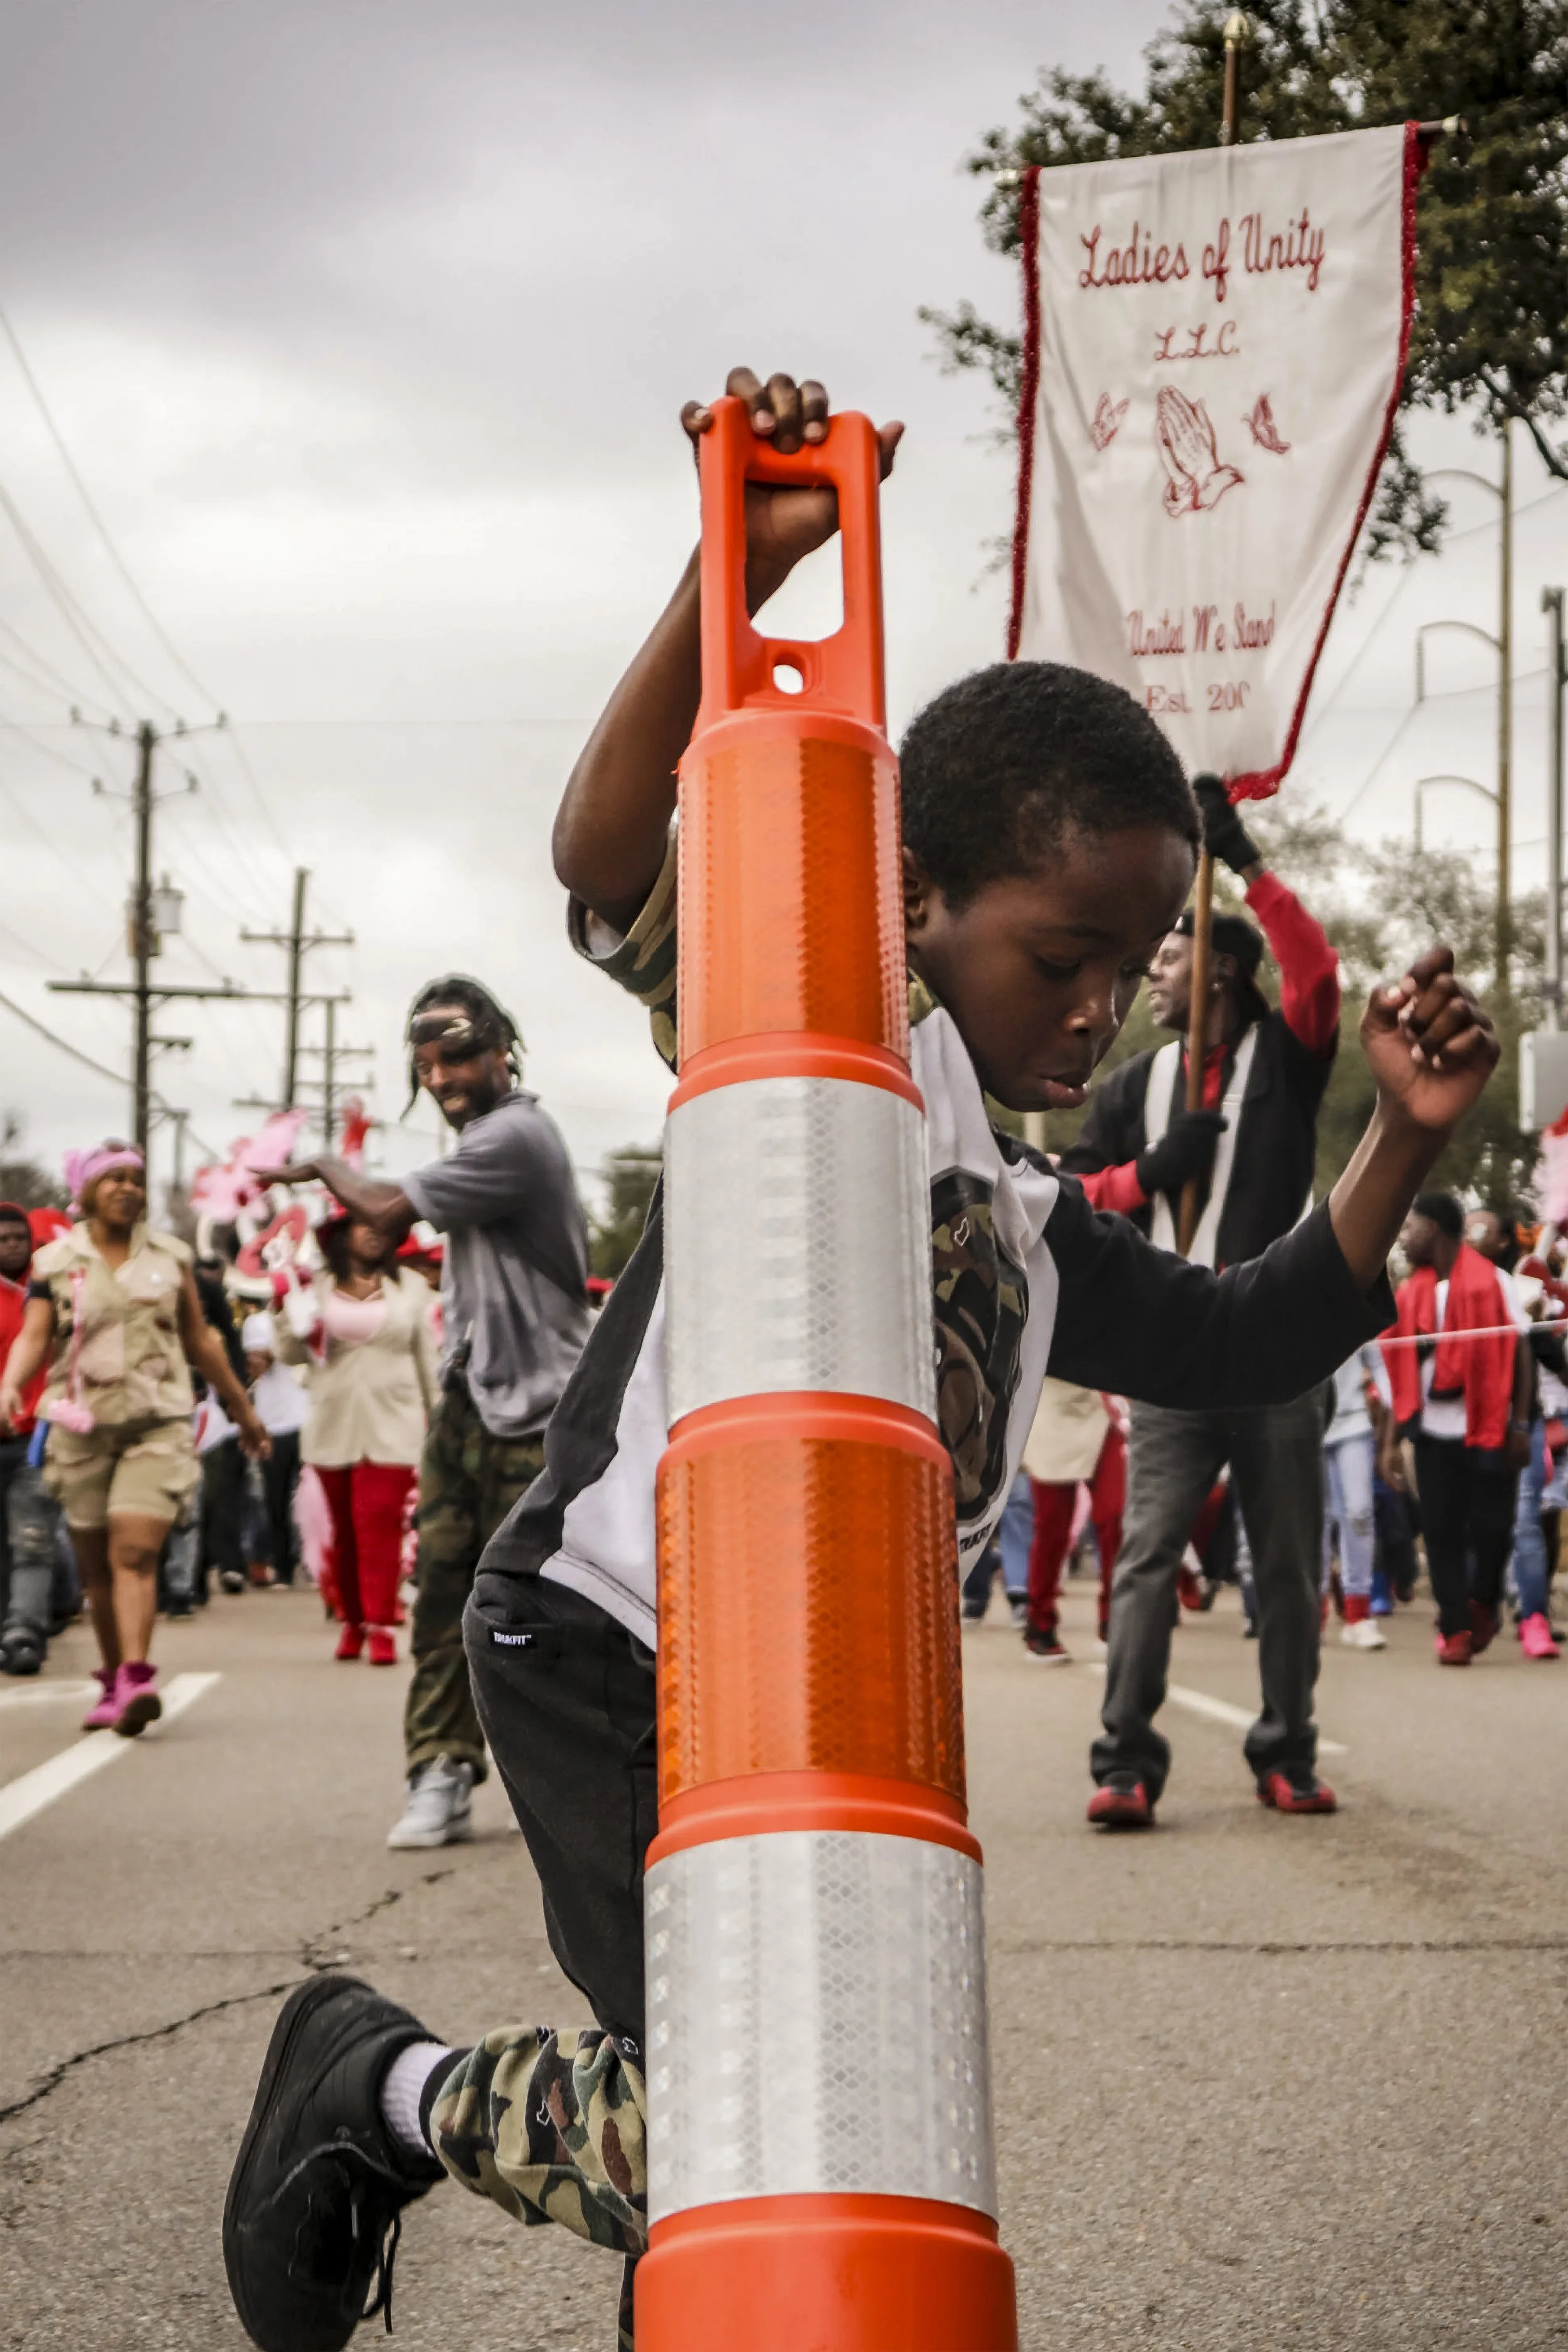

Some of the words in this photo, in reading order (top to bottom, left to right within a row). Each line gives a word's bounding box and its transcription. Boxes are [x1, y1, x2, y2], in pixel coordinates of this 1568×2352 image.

[1079, 220, 1190, 288] Ladies
[1202, 216, 1231, 302] of
[1238, 206, 1325, 291] Unity
[1193, 604, 1225, 653] We
